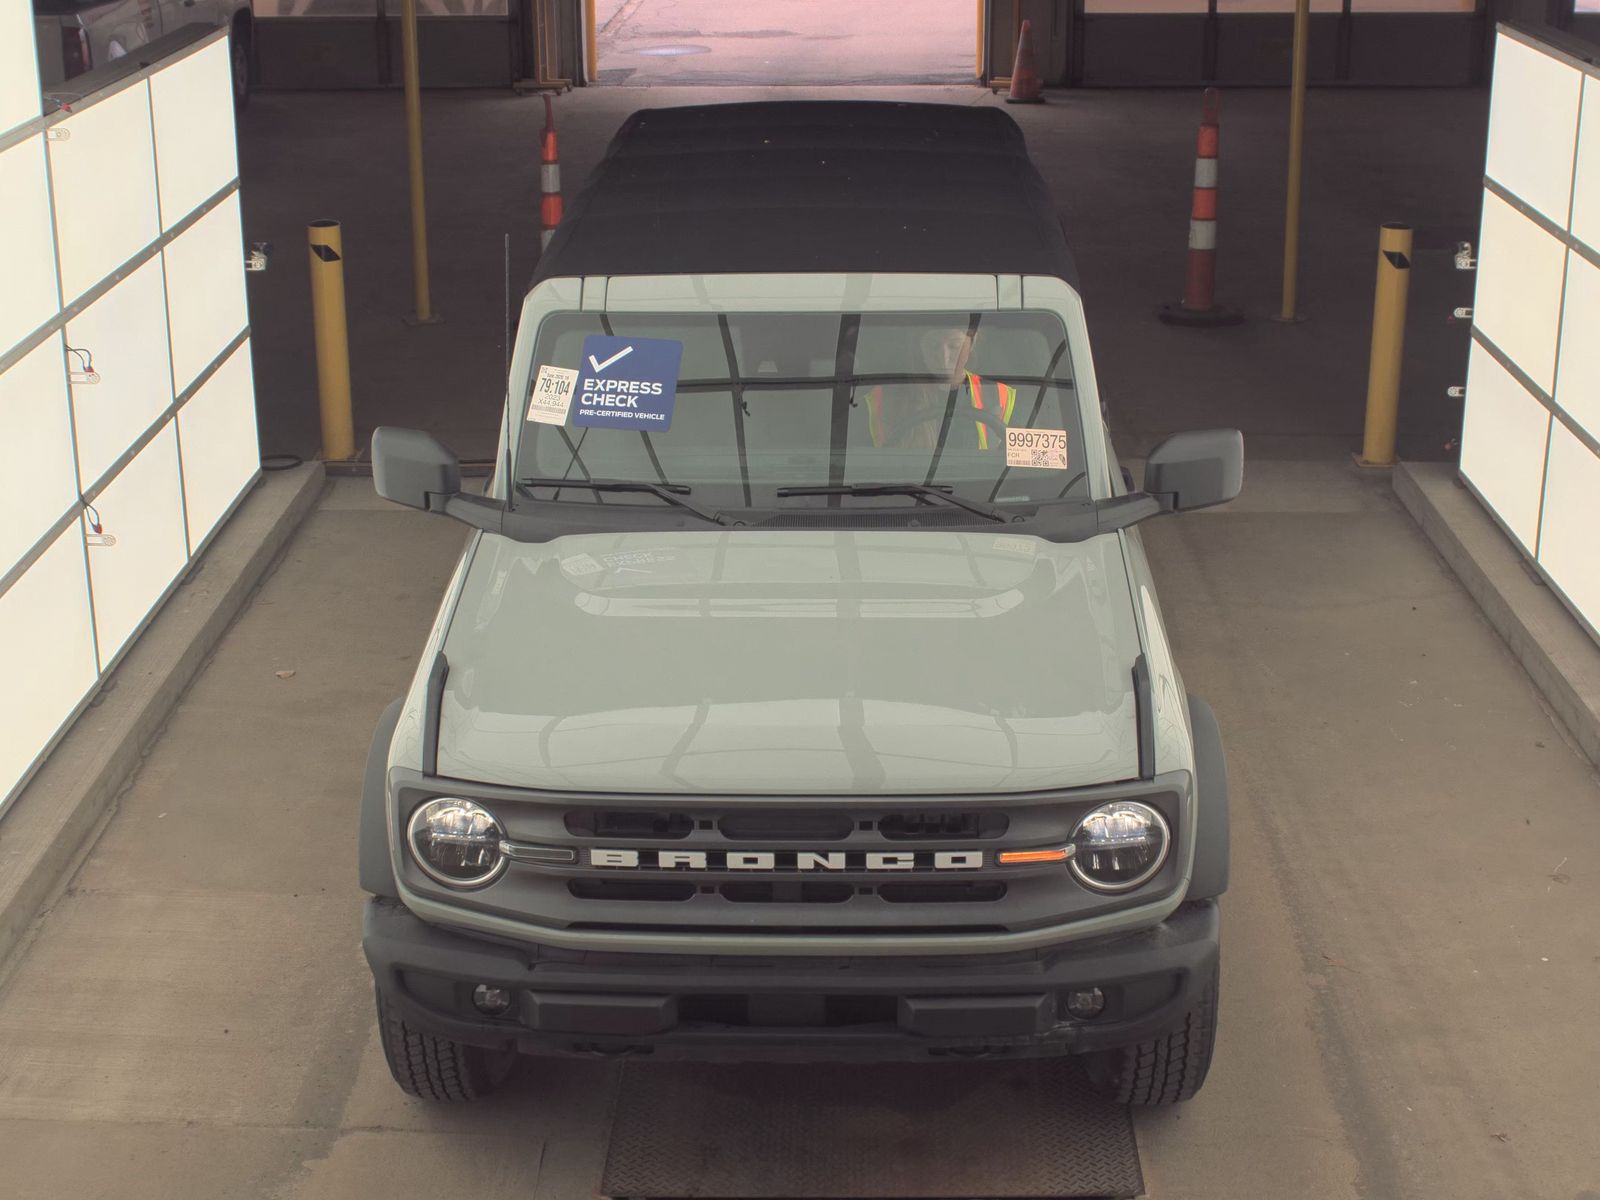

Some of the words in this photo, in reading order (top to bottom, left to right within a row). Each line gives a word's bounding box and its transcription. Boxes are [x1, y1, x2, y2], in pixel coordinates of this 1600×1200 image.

[540, 377, 571, 396] 79:104
[583, 378, 663, 395] EXPRESS
[581, 393, 639, 408] CHECK
[579, 409, 633, 418] PRE-CERTIFIED
[634, 412, 665, 421] VEHICLE
[1008, 432, 1066, 449] 9997375
[590, 849, 983, 869] BRONCO
